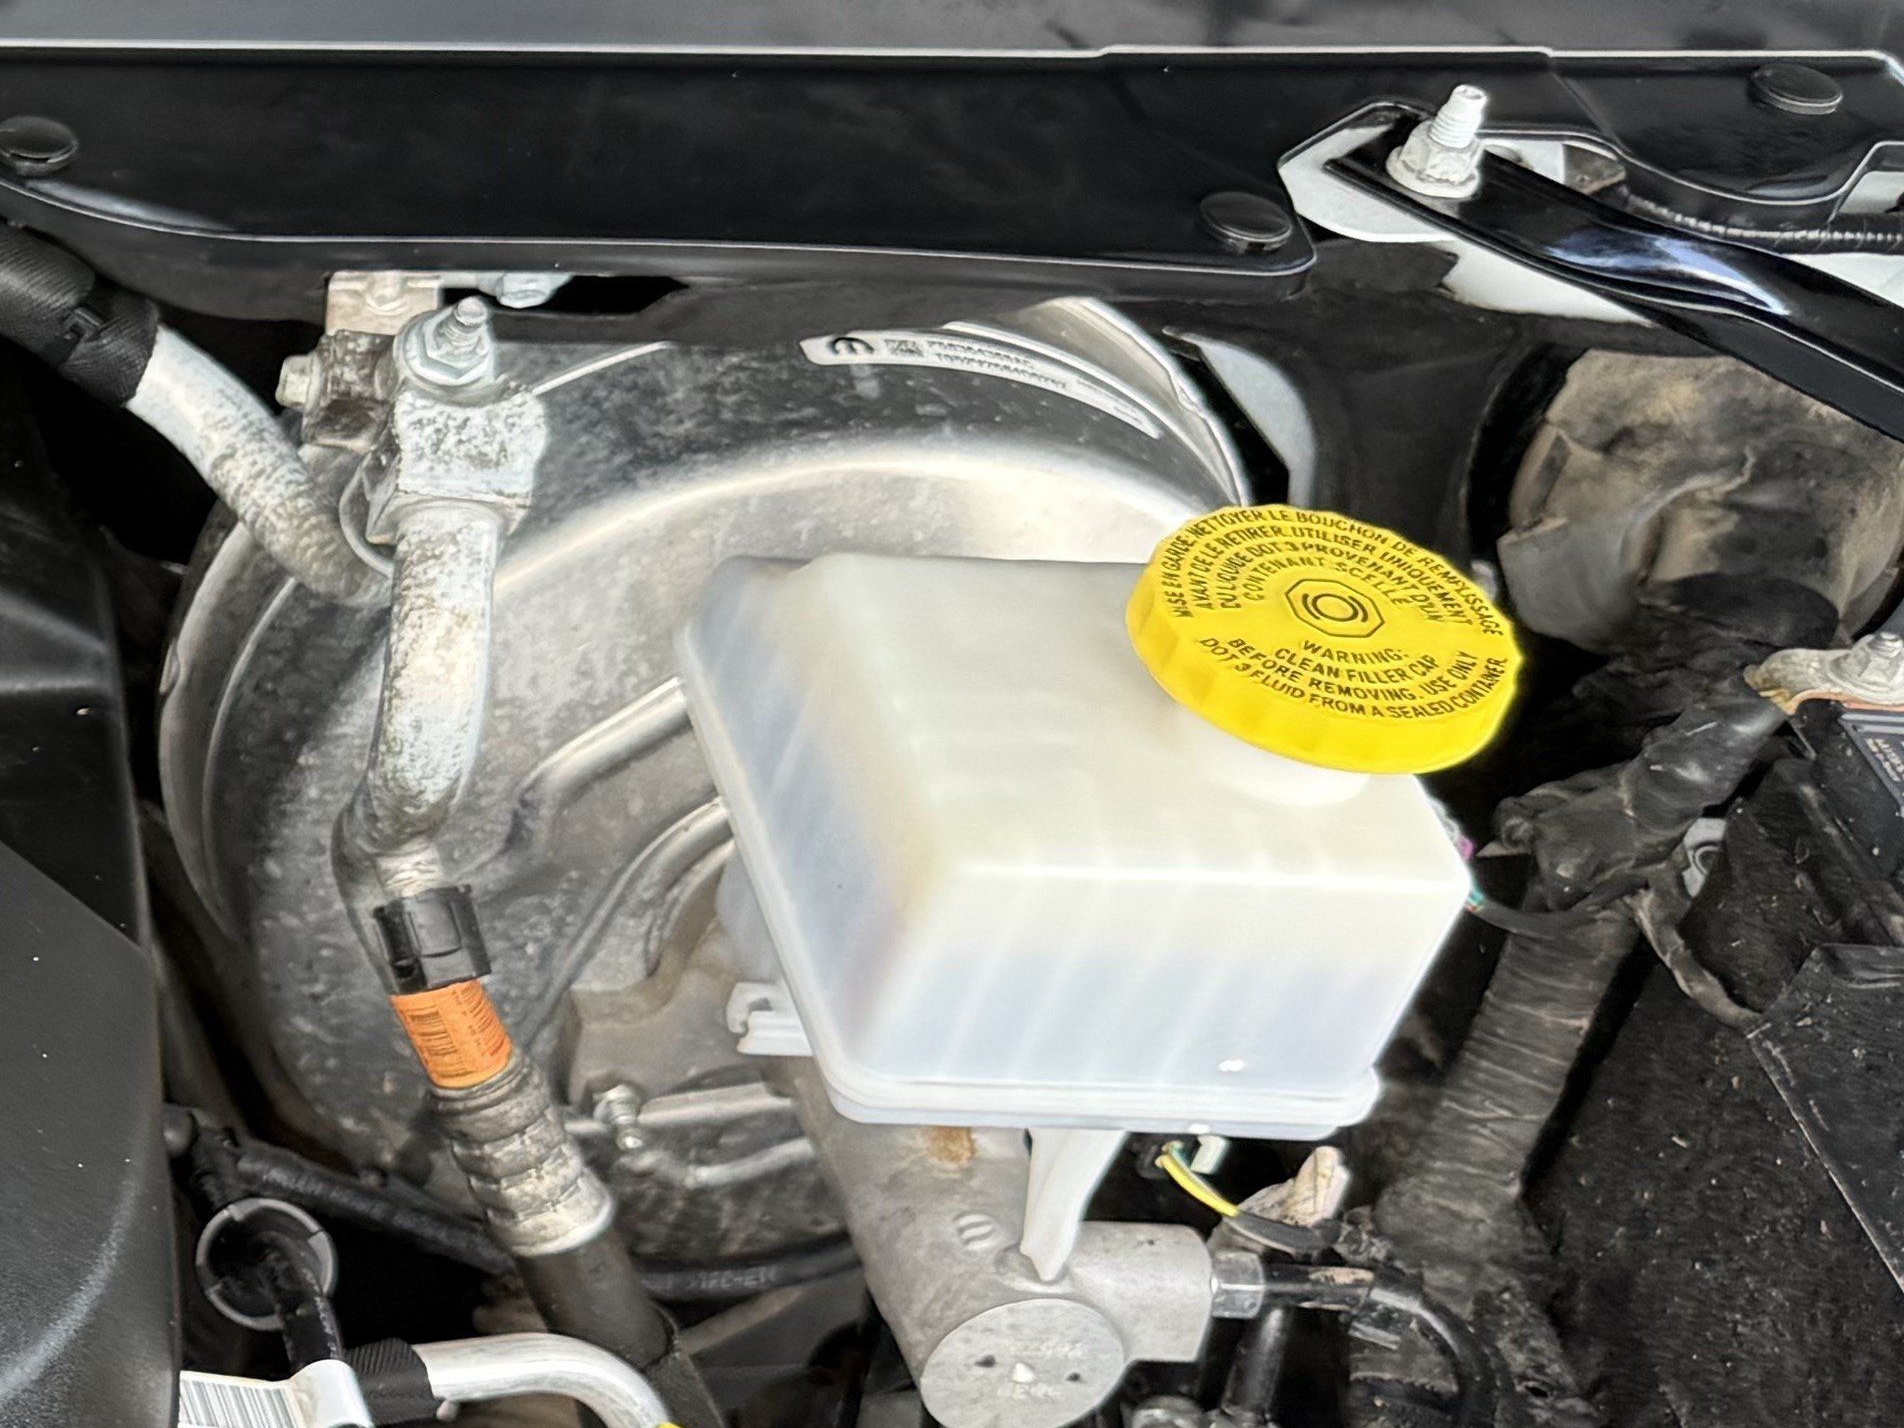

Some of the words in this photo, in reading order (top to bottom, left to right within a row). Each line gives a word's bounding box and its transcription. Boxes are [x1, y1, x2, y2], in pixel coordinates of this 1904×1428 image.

[1199, 542, 1224, 559] LE
[1291, 526, 1376, 554] UTILISER
[1161, 571, 1182, 588] EN
[1185, 510, 1267, 539] NETTOYER
[1268, 510, 1292, 522] LE
[1296, 512, 1389, 544] BOUCHON
[1392, 541, 1418, 557] DE
[1418, 557, 1504, 636] REMPLISSAGE
[1189, 555, 1214, 572] DE
[1216, 592, 1242, 609] DU
[1245, 542, 1282, 557] DOT
[1284, 541, 1299, 552] 3
[1301, 541, 1419, 591] PROVENANT
[1243, 556, 1325, 601] CONTENANT
[1187, 571, 1214, 609] AVANT
[1380, 552, 1473, 625] UNIQUEMENT
[1199, 638, 1238, 663] DOT
[1235, 661, 1252, 672] 3
[1249, 670, 1305, 699] FLUID
[1308, 695, 1366, 716] FROM
[1370, 704, 1384, 717] A
[1385, 700, 1455, 719] SEALED
[1227, 638, 1302, 683] BEFORE
[1419, 675, 1456, 695] USE
[1447, 650, 1478, 680] ONLY
[1275, 648, 1340, 680] CLEAN
[1347, 667, 1410, 685] FILLER
[1411, 655, 1440, 677] CAP
